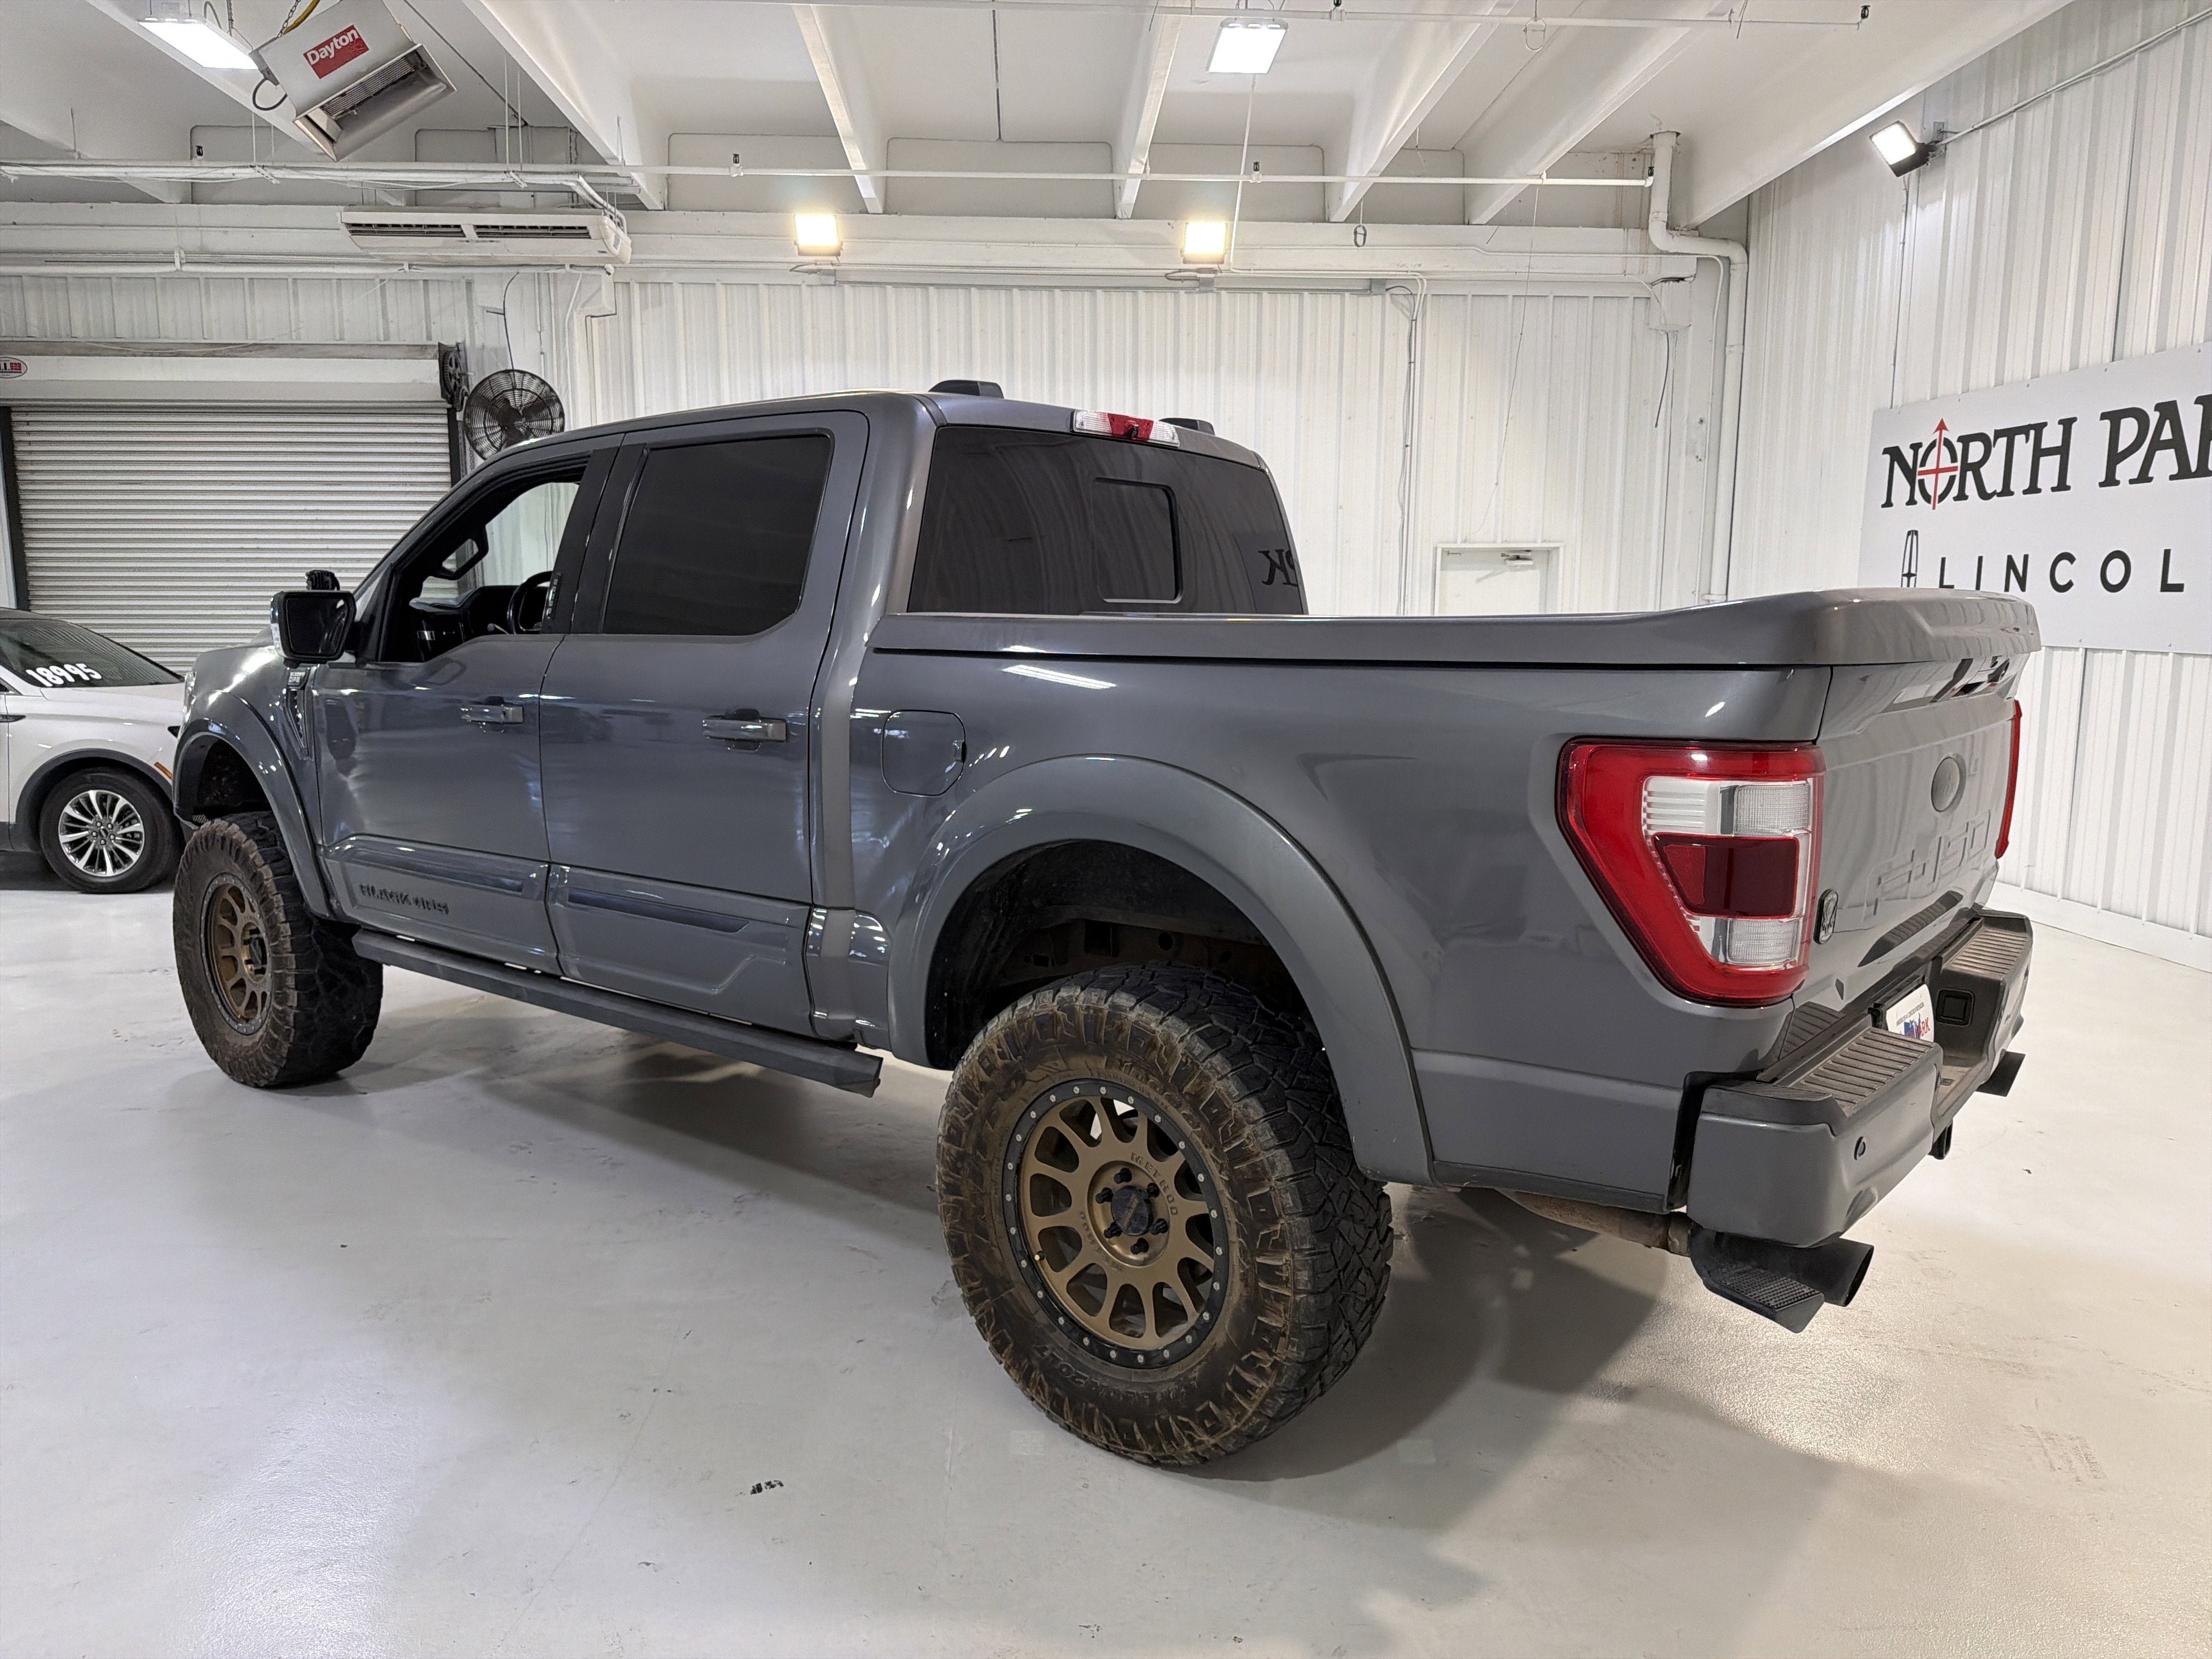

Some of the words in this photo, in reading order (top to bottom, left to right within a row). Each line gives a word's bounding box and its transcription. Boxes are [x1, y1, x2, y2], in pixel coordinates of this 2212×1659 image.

[306, 28, 359, 65] Dayton
[1881, 417, 2078, 509] NORTH
[26, 663, 102, 686] 18995
[1131, 1153, 1178, 1215] METHOD
